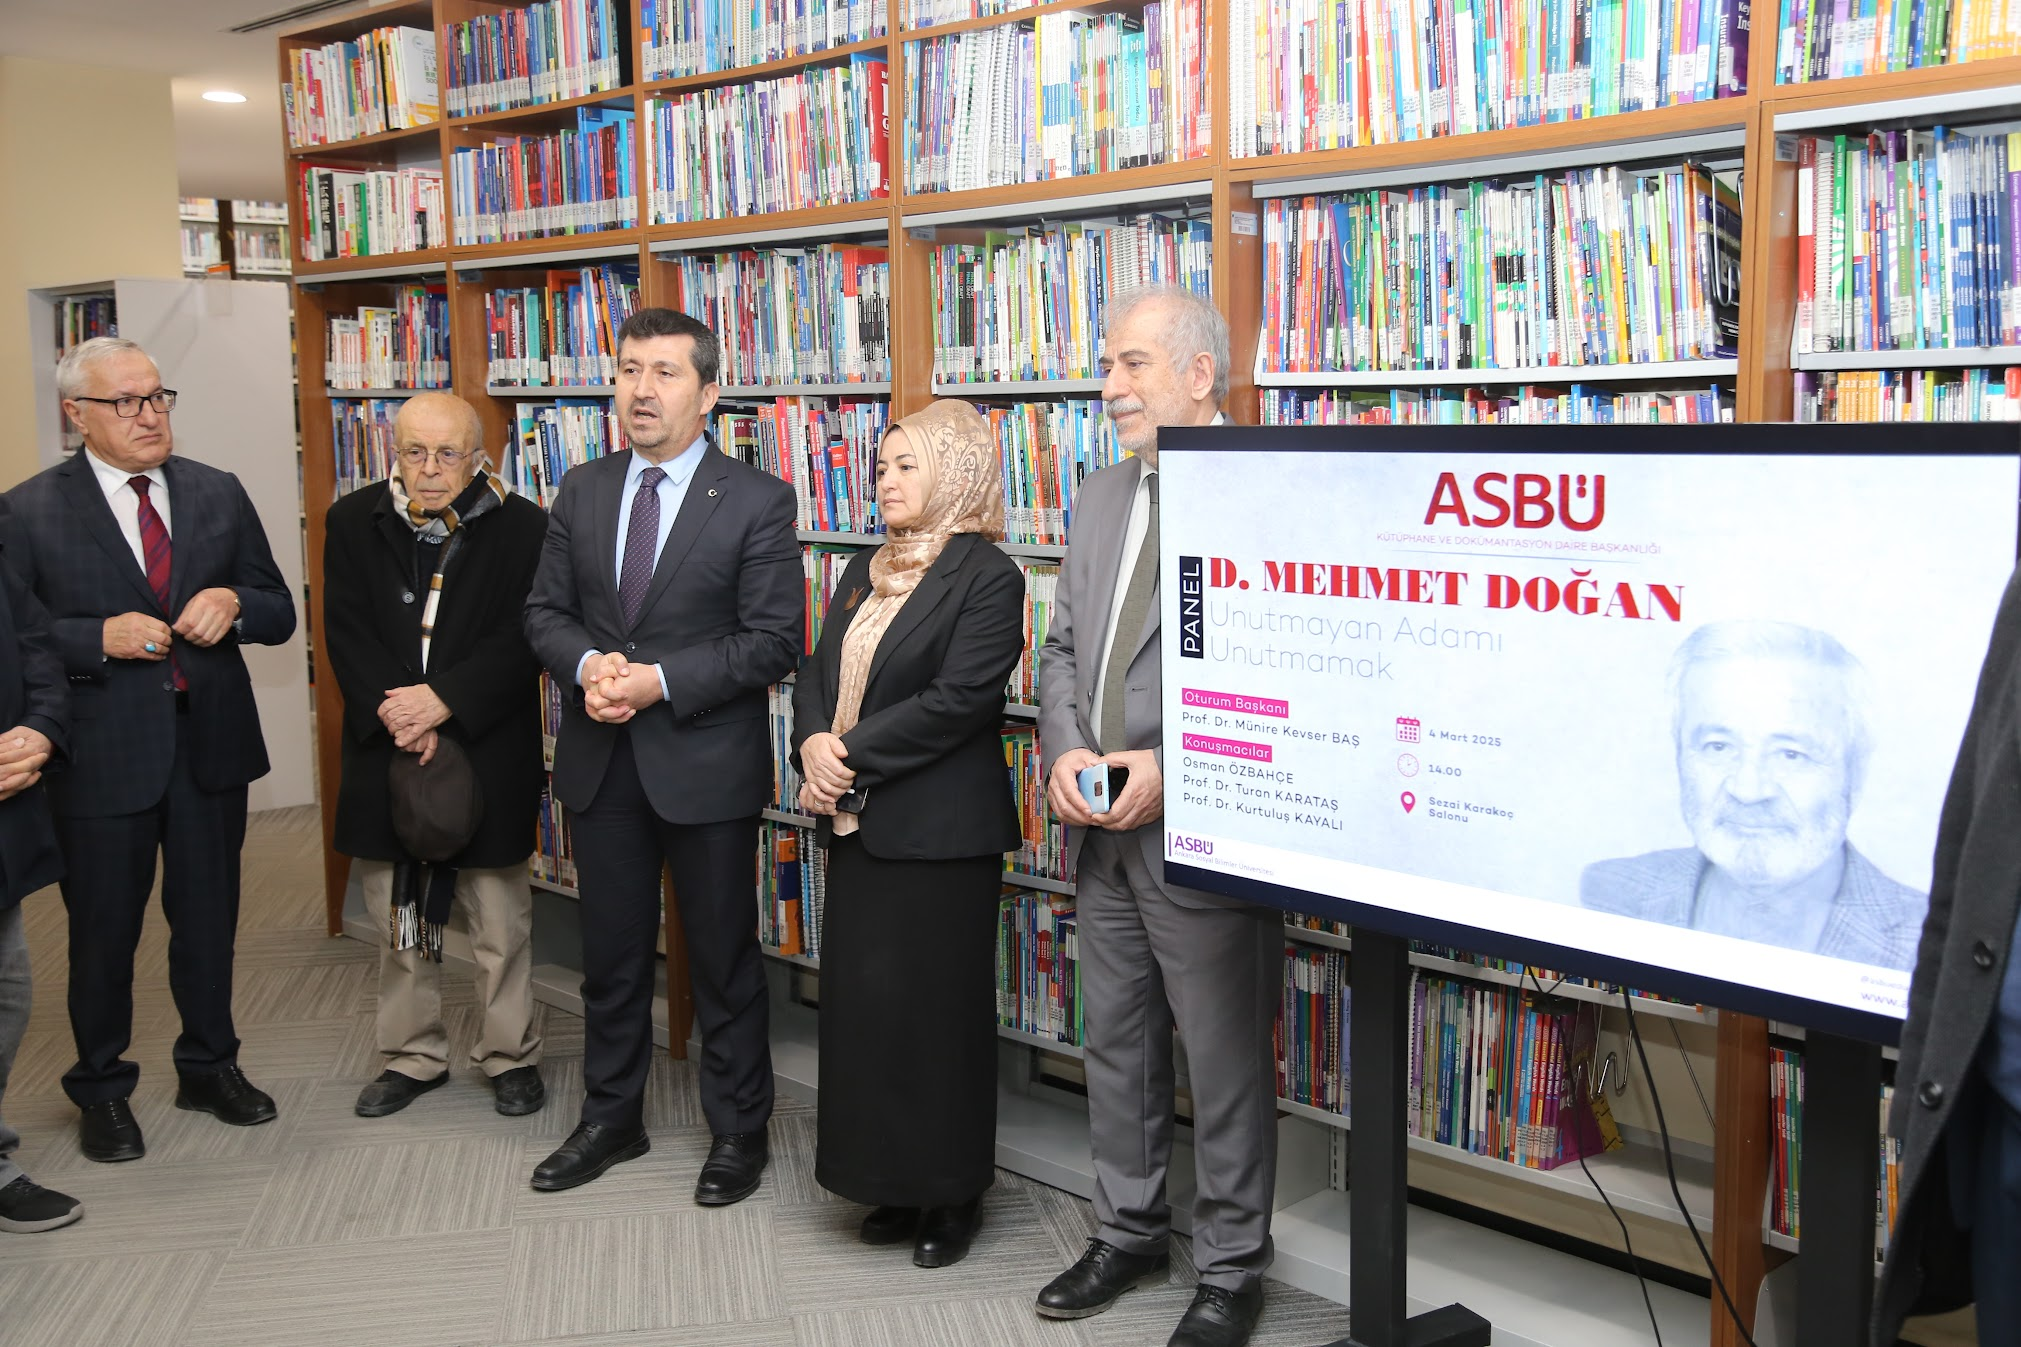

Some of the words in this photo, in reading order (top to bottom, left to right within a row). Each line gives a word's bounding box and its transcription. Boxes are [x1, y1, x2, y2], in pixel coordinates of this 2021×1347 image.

[1424, 472, 1605, 531] ASBÜ
[1377, 532, 1436, 544] KÜTÜPHANE
[1439, 535, 1452, 545] VE
[1455, 536, 1552, 549] DOKÜMANTASYON
[1591, 542, 1661, 554] BAŞKANLIĞI
[1209, 557, 1249, 590] D.
[1262, 561, 1468, 605] MEHMET
[1484, 568, 1684, 621] DOĞAN
[1183, 563, 1199, 654] PANEL
[1211, 601, 1382, 645] Unutmayan
[1393, 617, 1501, 652] Adamı
[1211, 635, 1393, 680] Unutmamak
[1184, 691, 1231, 707] Oturum
[1235, 697, 1286, 715] Başkanı
[1183, 712, 1210, 725] Prof.
[1215, 716, 1231, 728] Dr.
[1236, 719, 1278, 735] Münire
[1283, 726, 1327, 741] Kevser
[1333, 732, 1359, 748] BAŞ
[1429, 729, 1436, 738] 4
[1440, 730, 1468, 742] Mart
[1472, 734, 1501, 747] 2025
[1184, 735, 1269, 758] Konuşmacılar
[1183, 756, 1225, 773] Osman
[1229, 761, 1294, 785] ÖZBAHÇE
[1429, 764, 1462, 777] 14.00
[1183, 774, 1210, 789] Prof.
[1215, 779, 1231, 792] Dr.
[1235, 783, 1270, 798] Turan
[1275, 790, 1338, 813] KARATAŞ
[1183, 792, 1211, 806] Prof.
[1216, 797, 1231, 811] Dr.
[1237, 801, 1290, 823] Kurtuluş
[1295, 812, 1342, 831] KAYALI
[1429, 797, 1460, 809] Sezai
[1464, 802, 1513, 820] Karakoç
[1429, 808, 1468, 823] Salonu
[1174, 835, 1213, 855] ASBÜ
[1174, 850, 1194, 859] Ankara
[1195, 853, 1213, 864] Sosyal
